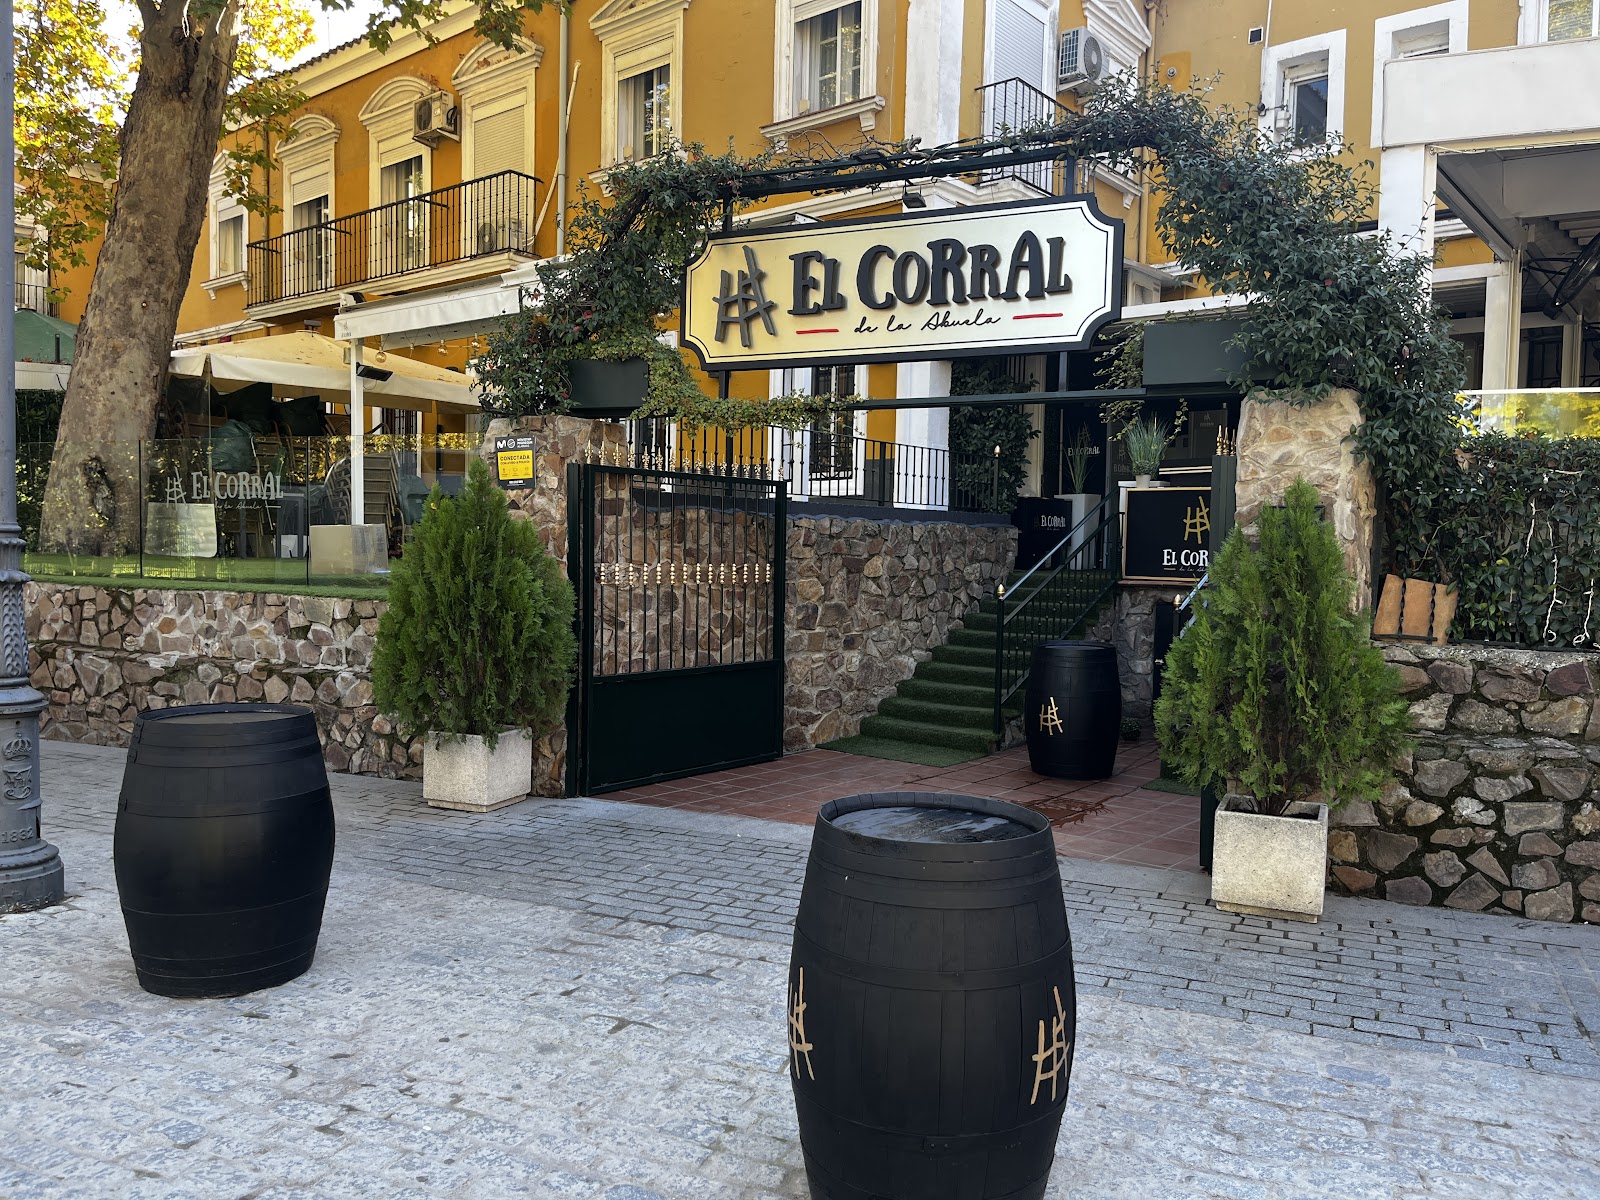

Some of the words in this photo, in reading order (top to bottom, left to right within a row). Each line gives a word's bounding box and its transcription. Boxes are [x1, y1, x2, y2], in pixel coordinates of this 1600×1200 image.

[787, 250, 846, 316] EL
[856, 229, 1073, 310] CORRAL
[854, 316, 879, 333] de
[886, 314, 912, 332] la
[920, 308, 1002, 331] Abuela
[191, 471, 211, 499] EL
[214, 471, 284, 500] CORRAL
[1162, 548, 1178, 566] EL
[1180, 549, 1209, 567] COR
[1, 826, 34, 844] 1832
